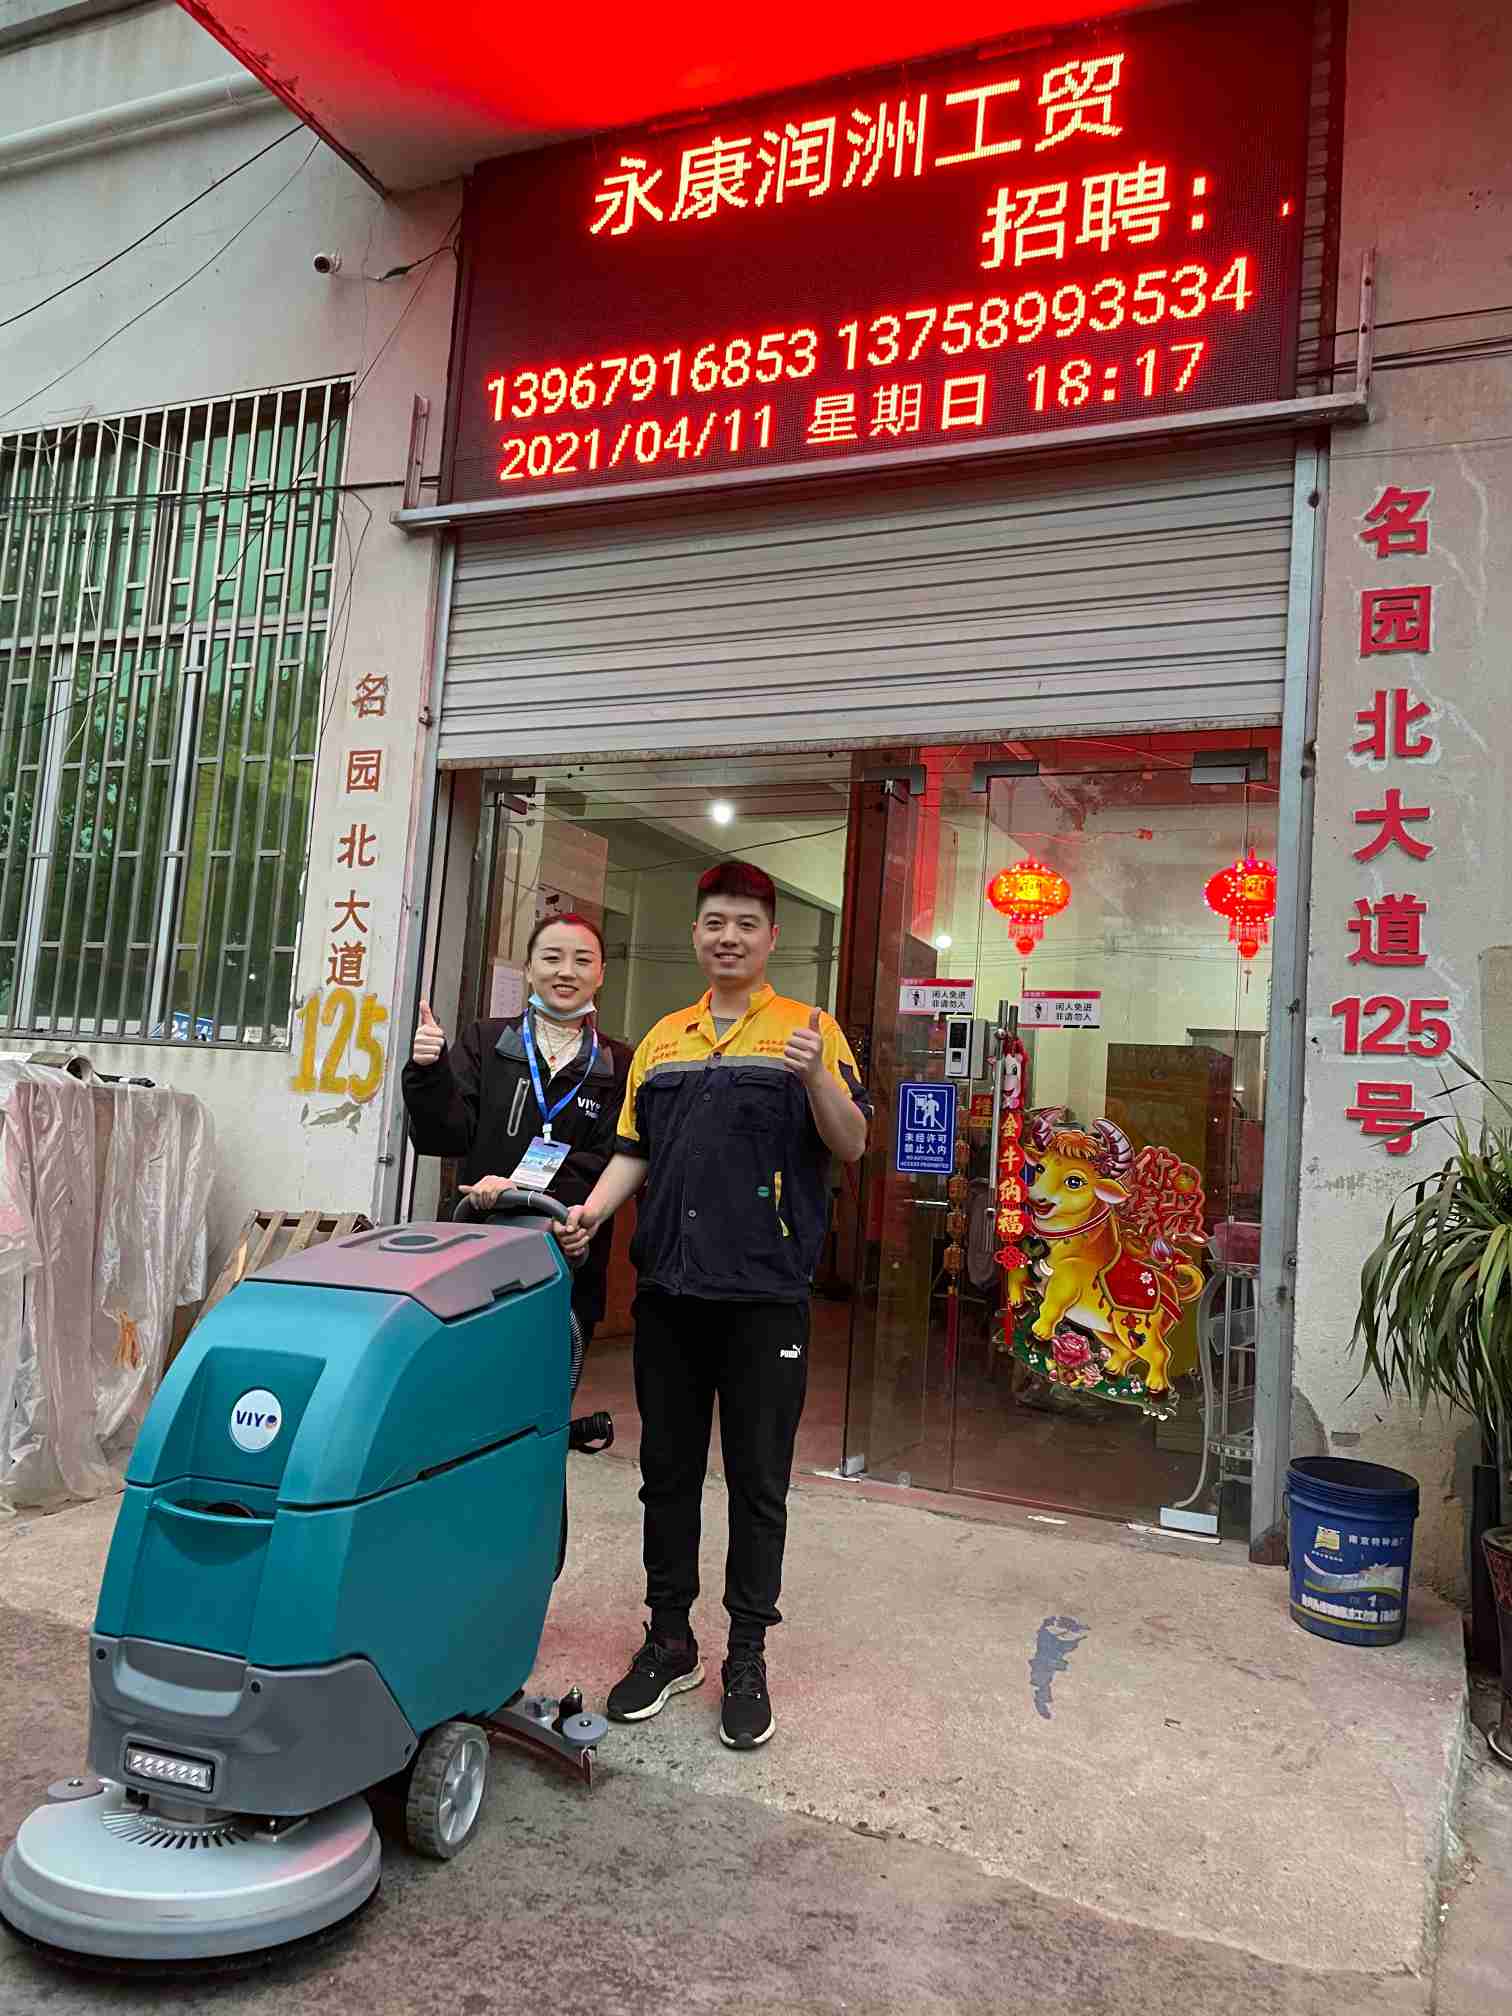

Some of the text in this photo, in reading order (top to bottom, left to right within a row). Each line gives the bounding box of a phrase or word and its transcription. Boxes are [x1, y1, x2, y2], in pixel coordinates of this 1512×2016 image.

[589, 52, 1125, 236] 永康润洲工贸
[488, 256, 1253, 422] 13967916853 13758993534
[499, 341, 1204, 481] 2021/04/11 星期日 18:17
[289, 986, 389, 1105] 125
